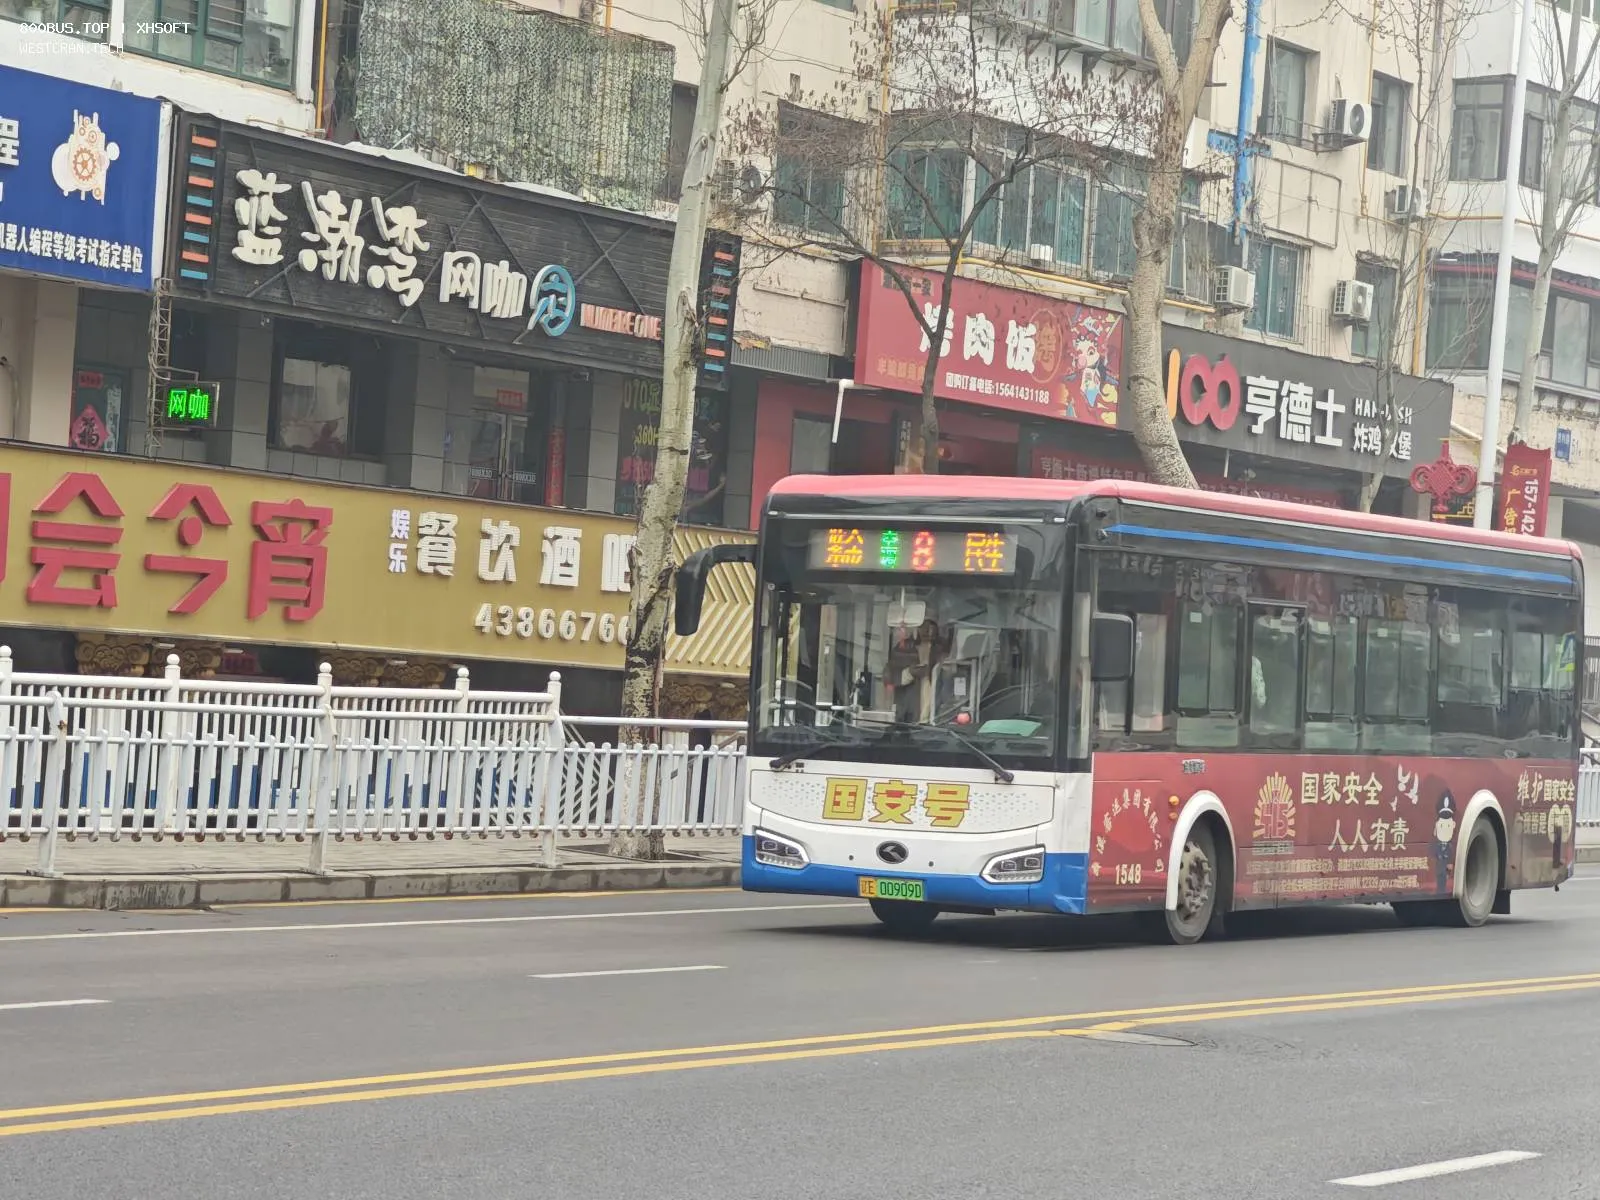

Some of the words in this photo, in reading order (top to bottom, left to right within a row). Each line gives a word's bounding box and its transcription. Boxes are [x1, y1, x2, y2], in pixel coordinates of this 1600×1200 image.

[168, 389, 209, 420] 网咖
[1245, 374, 1346, 448] 亨德士
[0, 471, 334, 621] 会今宵
[822, 776, 971, 828] 国安号
[1301, 771, 1383, 806] 国家安全
[1516, 769, 1576, 807] 维护国家安全
[1328, 817, 1410, 853] 人人有责
[1115, 863, 1142, 885] 1548
